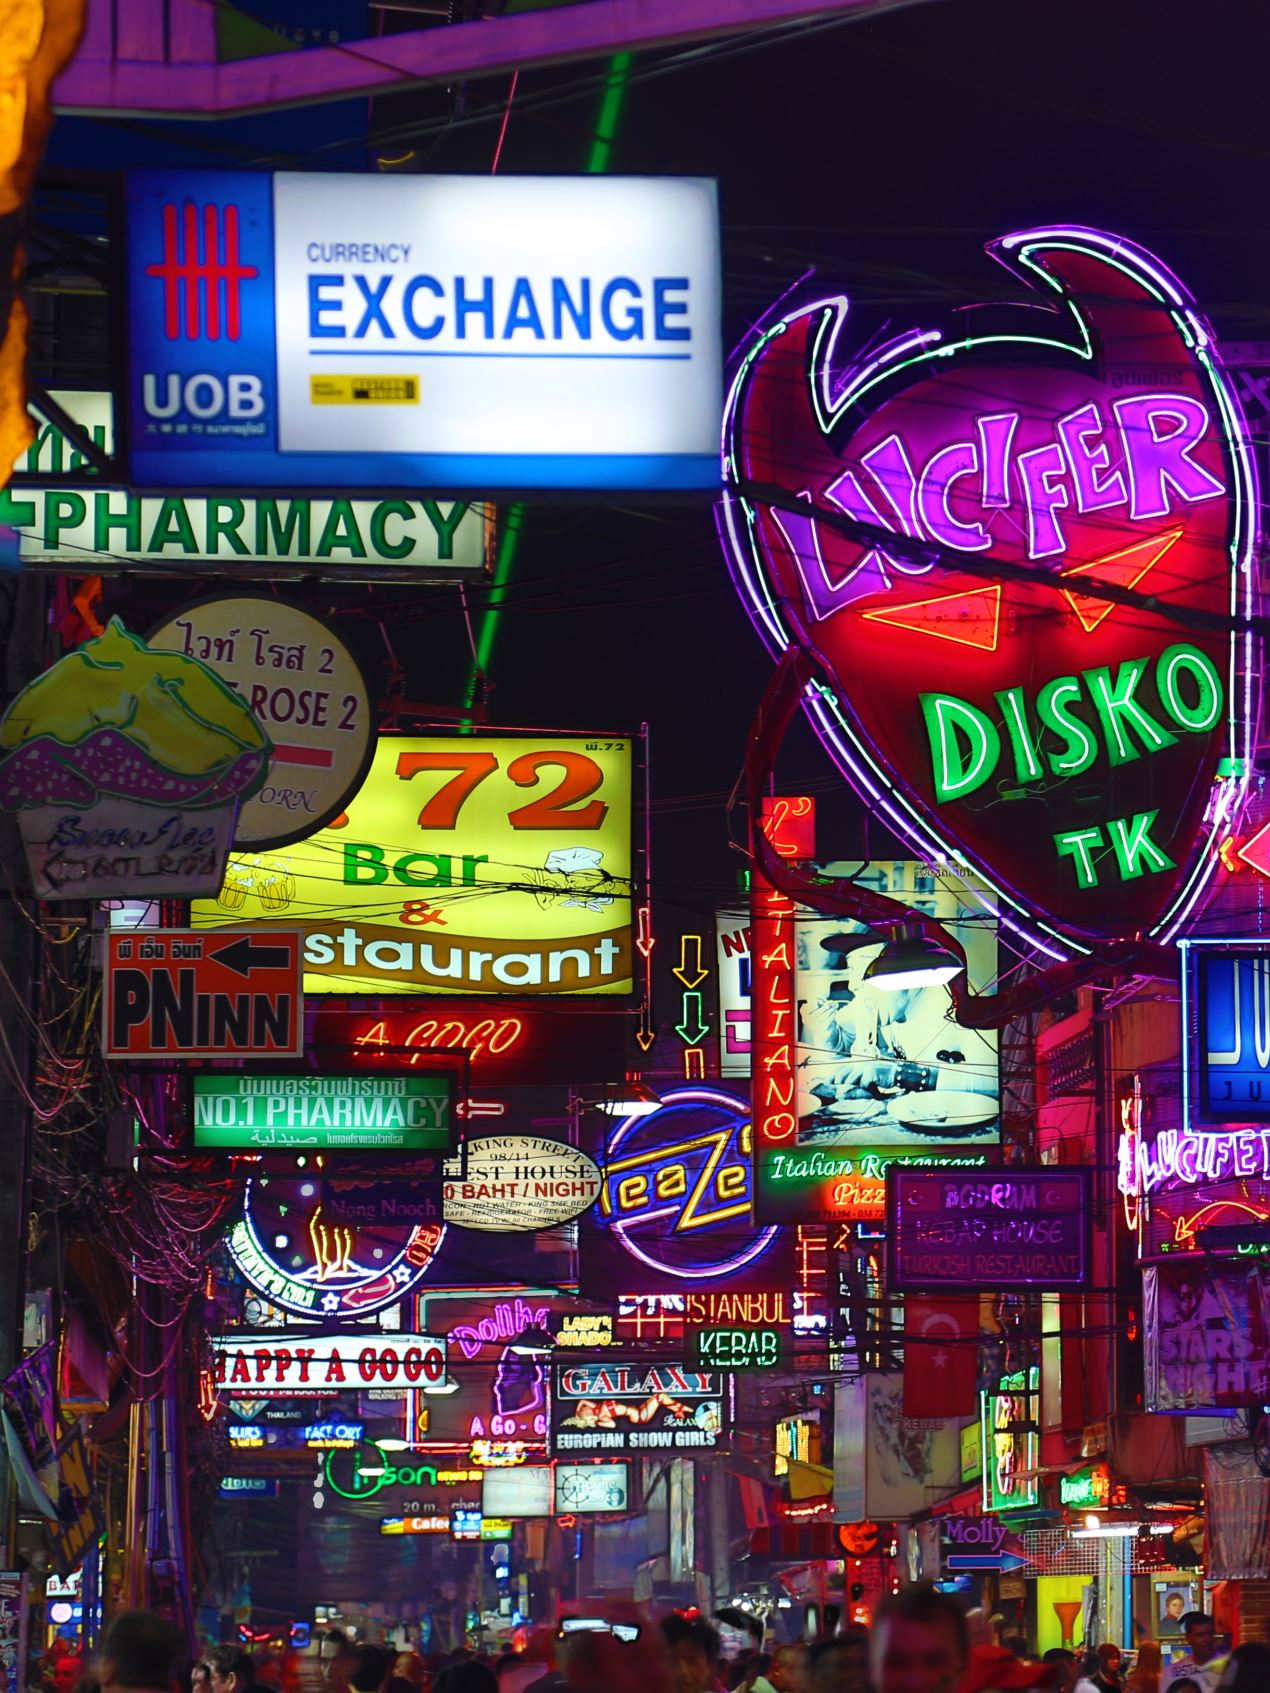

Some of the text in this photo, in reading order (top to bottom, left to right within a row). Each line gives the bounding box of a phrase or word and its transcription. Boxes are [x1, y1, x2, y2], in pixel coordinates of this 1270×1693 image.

[307, 242, 412, 264] CURRENCY
[308, 274, 692, 341] EXCHANGE
[143, 374, 265, 419] UOB
[43, 490, 468, 557] PHARMACY
[769, 394, 1226, 621] LUCIFER
[249, 628, 306, 671] โรส
[317, 647, 335, 674] 2
[337, 694, 358, 731] 2
[919, 643, 1224, 804] DISKO
[395, 750, 609, 831] 72
[342, 843, 489, 887] Bar
[1053, 809, 1177, 889] TK
[399, 900, 448, 926] &
[303, 927, 621, 986] staurant
[113, 968, 291, 1049] PN INN
[194, 1096, 449, 1128] NO.1 PHARMACY
[514, 1164, 593, 1181] HOUSE
[771, 1152, 853, 1180] Italian
[462, 1183, 519, 1199] BAHT
[534, 1181, 598, 1197] NIGHT
[993, 1219, 1064, 1245] HOUSE
[685, 1293, 792, 1324] ISTANBUL
[325, 1347, 346, 1382] A
[699, 1331, 777, 1366] KEBAB
[560, 1362, 713, 1395] GALAXY
[629, 1432, 673, 1448] SHOW
[675, 1431, 717, 1447] GIRLS
